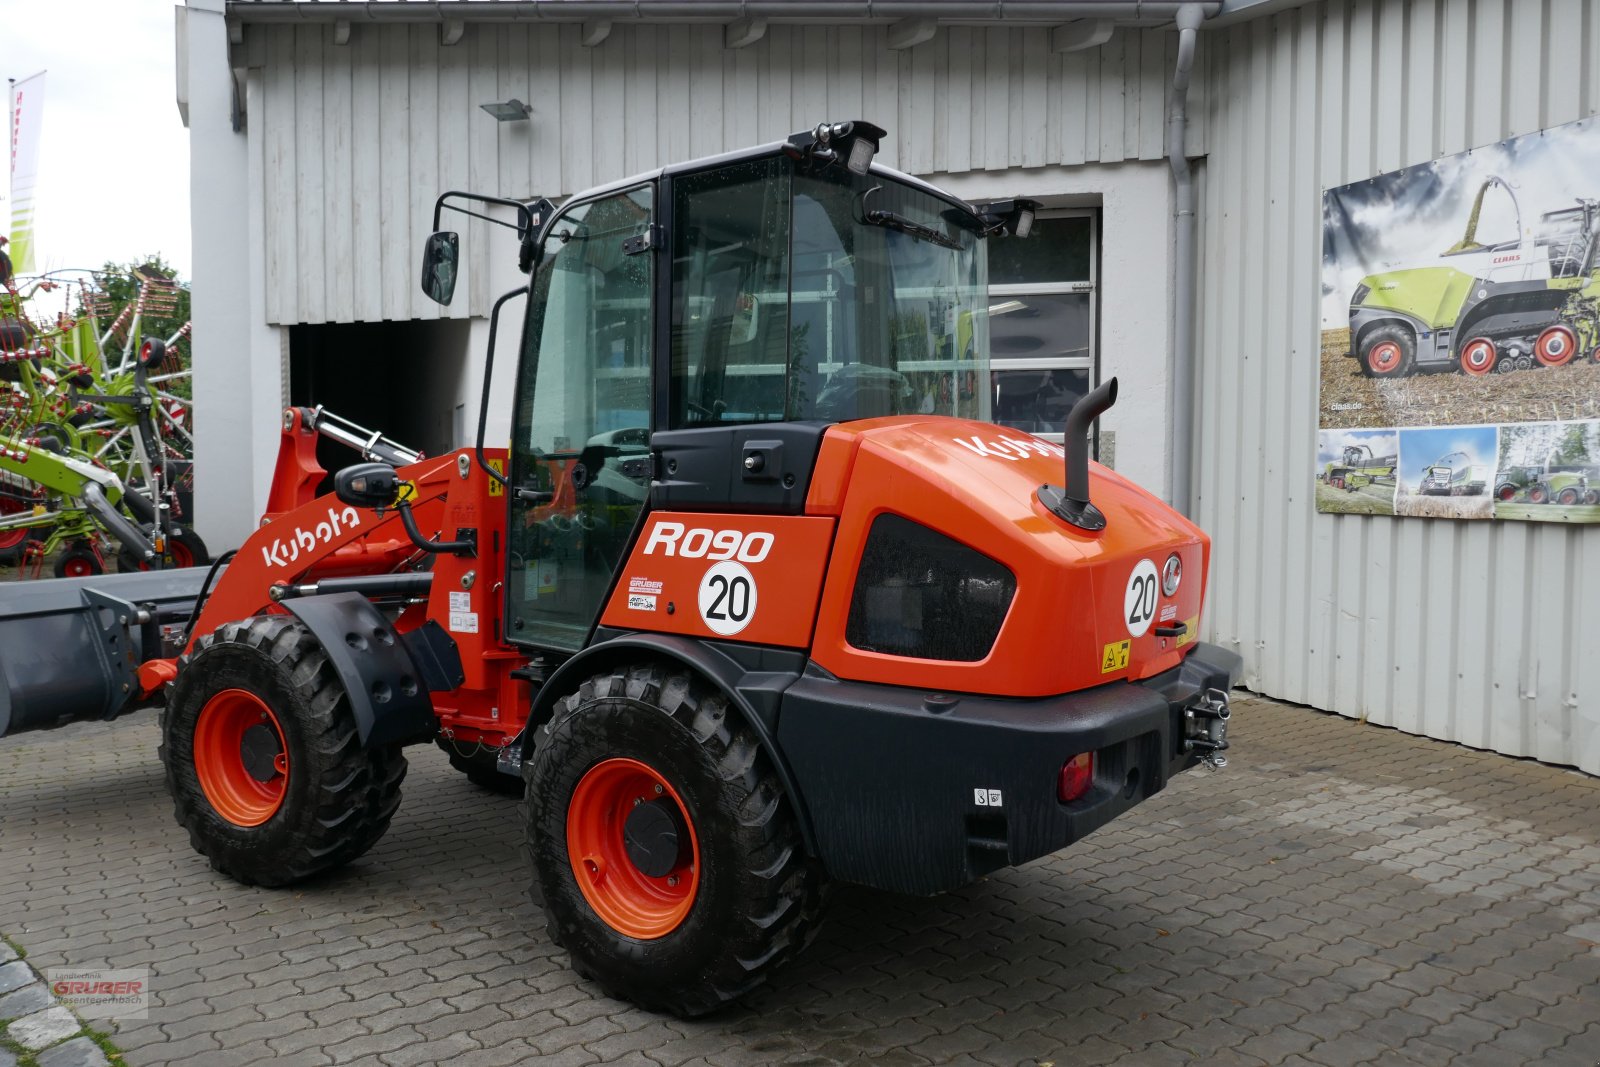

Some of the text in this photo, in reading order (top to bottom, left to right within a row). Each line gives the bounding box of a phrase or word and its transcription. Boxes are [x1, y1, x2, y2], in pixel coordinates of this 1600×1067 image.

[1331, 402, 1362, 410] claas.de
[262, 506, 360, 567] Kubota
[643, 521, 775, 563] R090
[630, 580, 663, 589] GRUBER
[706, 574, 750, 622] 20
[1129, 573, 1156, 624] 20
